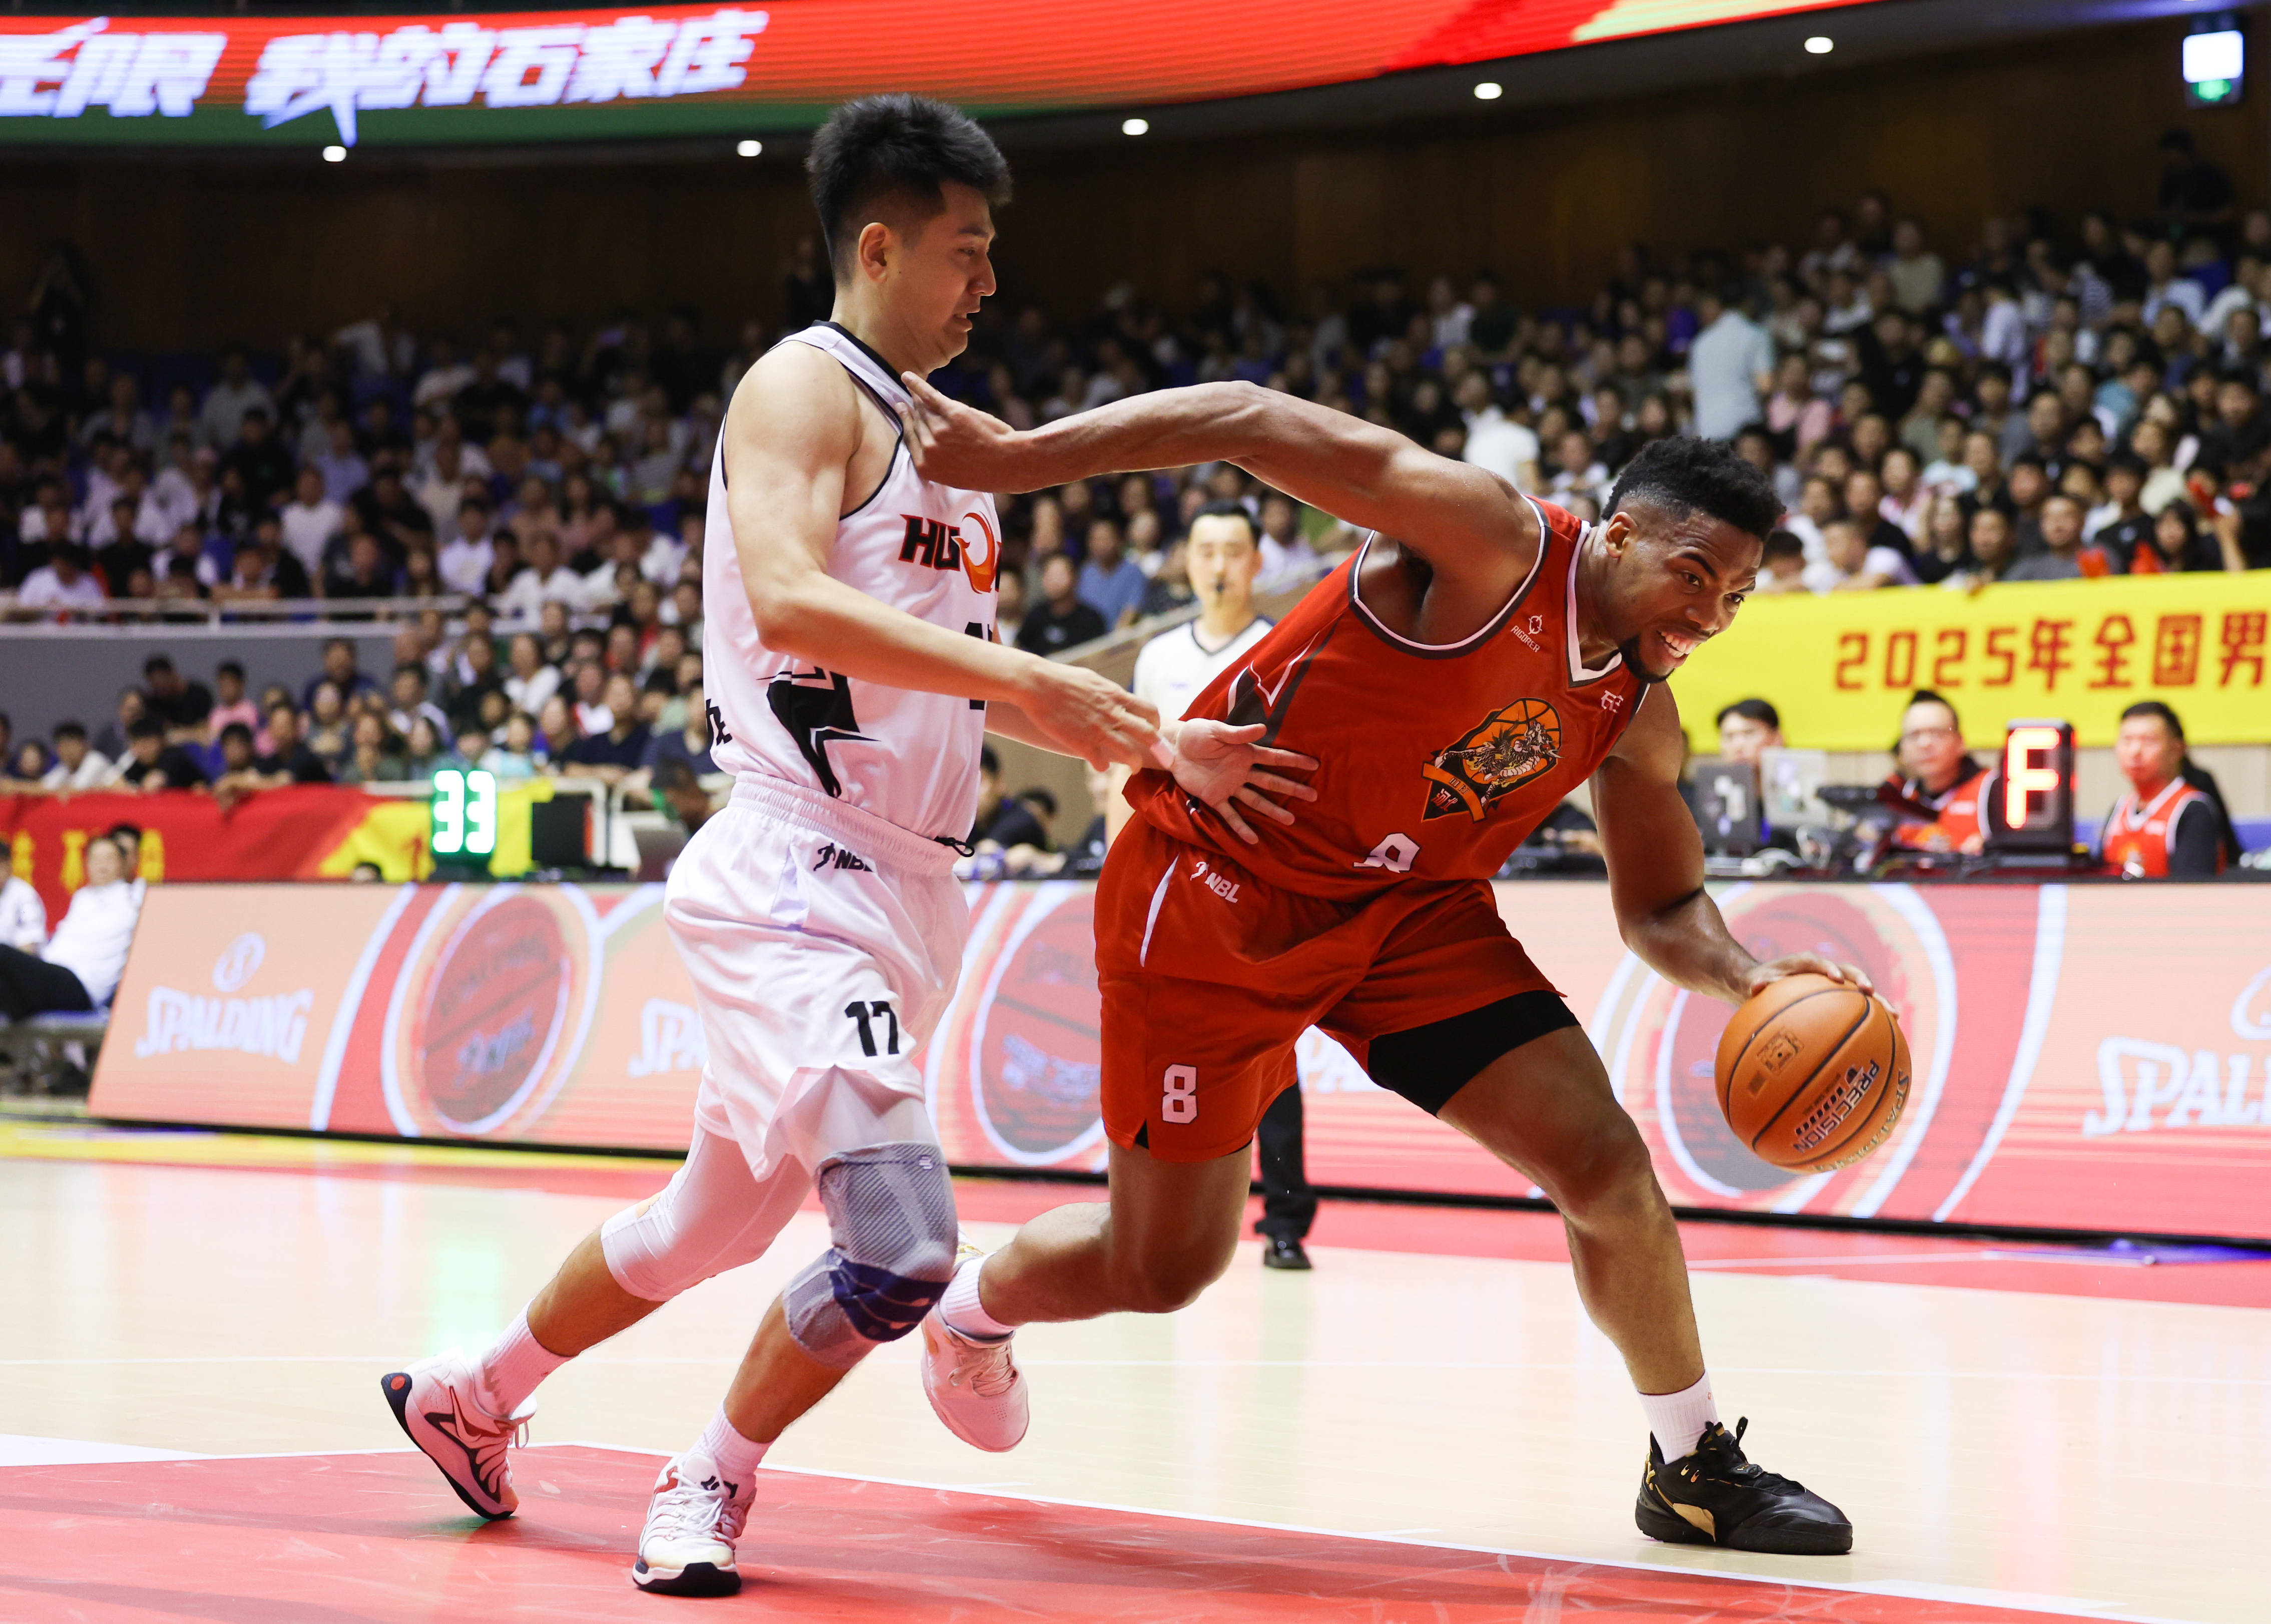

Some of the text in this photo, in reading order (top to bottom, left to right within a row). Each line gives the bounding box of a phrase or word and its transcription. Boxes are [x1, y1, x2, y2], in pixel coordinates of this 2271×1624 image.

[244, 8, 770, 148] 我的石家庄
[1510, 625, 1541, 653] RIGORER
[1836, 612, 2268, 692] 2025年全国男
[432, 769, 496, 854] 33
[1205, 872, 1240, 904] NBL
[135, 985, 314, 1065] SPALDING
[844, 1000, 900, 1057] 17
[1162, 1063, 1198, 1124] 8
[1793, 1059, 1881, 1154] PRECISION
[2082, 1035, 2271, 1139] SPAL
